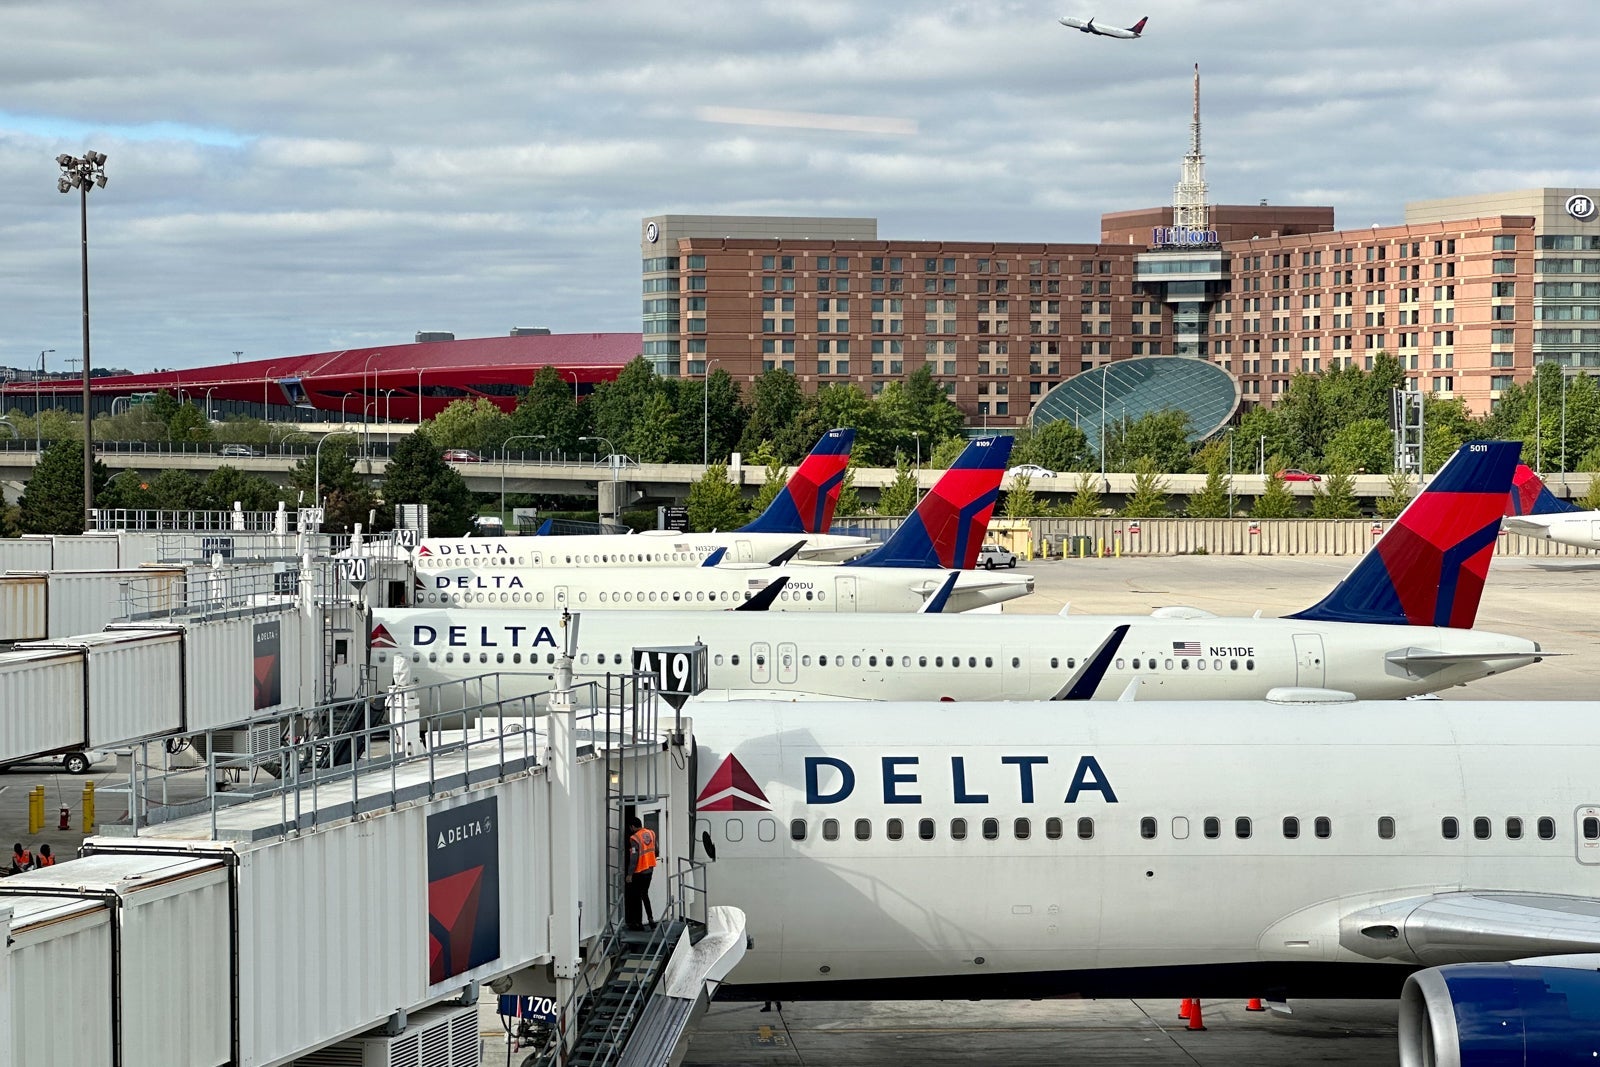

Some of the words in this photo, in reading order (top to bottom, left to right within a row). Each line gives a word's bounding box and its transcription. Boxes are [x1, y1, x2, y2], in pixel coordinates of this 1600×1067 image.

[1152, 226, 1219, 245] Hilton
[1470, 444, 1488, 452] 5011
[395, 530, 417, 546] A21
[439, 544, 508, 555] DELTA
[339, 558, 366, 580] A20
[436, 576, 524, 588] DELTA
[413, 625, 558, 648] DELTA
[1210, 647, 1255, 657] N511DE
[637, 651, 689, 692] A19
[804, 755, 1119, 805] DELTA
[448, 820, 482, 844] DELTA
